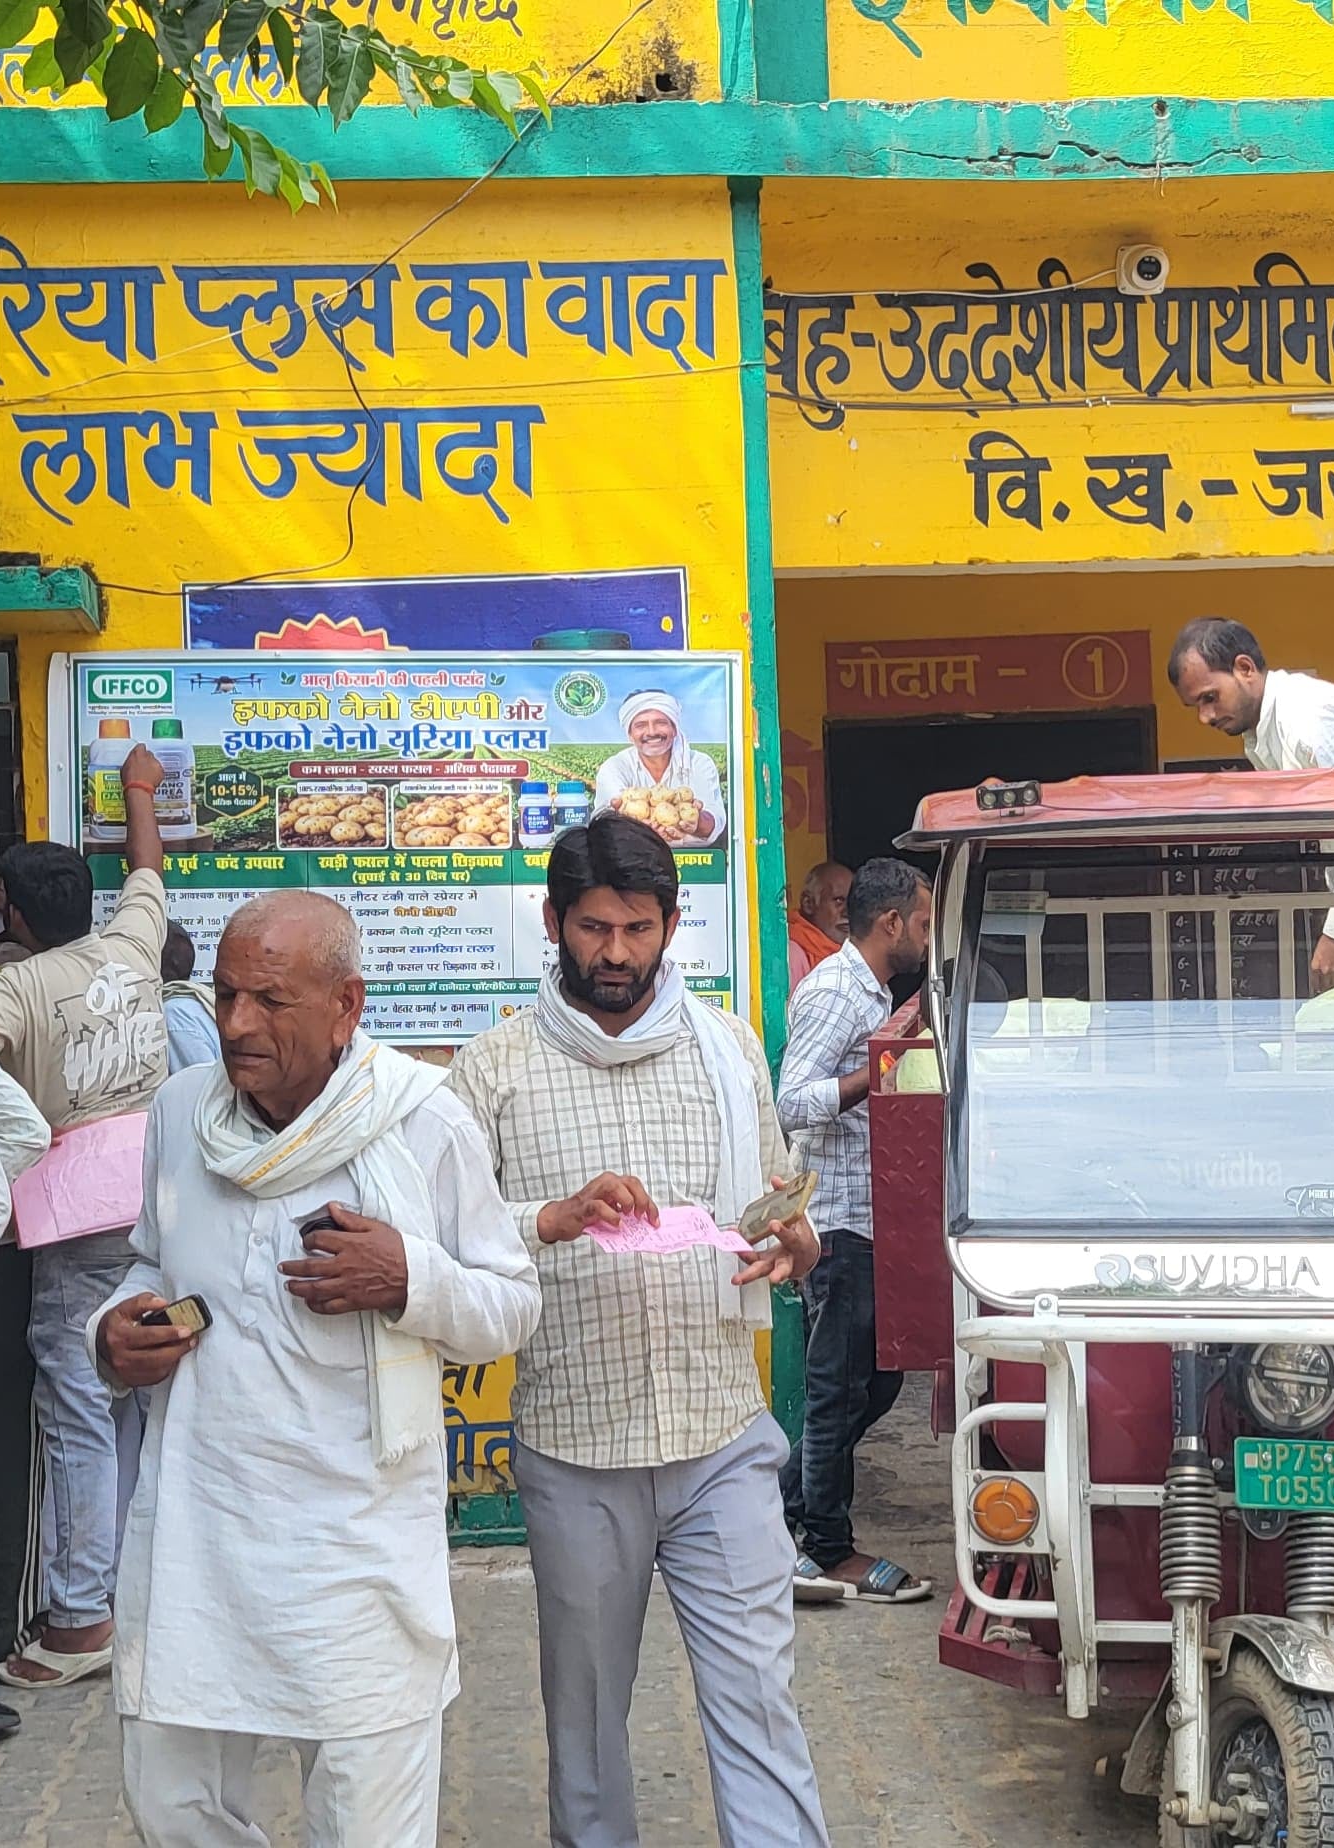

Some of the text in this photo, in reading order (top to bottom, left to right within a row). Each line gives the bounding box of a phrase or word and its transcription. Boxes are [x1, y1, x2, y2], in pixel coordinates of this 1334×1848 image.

[173, 264, 399, 373] प्लस
[411, 260, 530, 359] का
[540, 259, 727, 372] वादा
[12, 411, 219, 526] लाभ
[236, 405, 546, 524] ज्यादा
[837, 646, 980, 697] गोदाम
[101, 678, 160, 695] IFFCO
[301, 672, 484, 689] आलू किसानों की पहली पसंद
[231, 691, 545, 726] इफको नैनो डीएपी और
[223, 723, 548, 758] इफको नैनो यूरिया प्लस
[302, 763, 517, 775] कम लागत स्वस्थ फसल अधिक पैदावार
[209, 786, 258, 797] 10-15%
[244, 857, 285, 870] उपचार
[318, 854, 348, 871] खड़ी
[398, 962, 423, 971] फसल
[427, 961, 440, 970] पर
[1133, 1254, 1321, 1287] SUVIDHA
